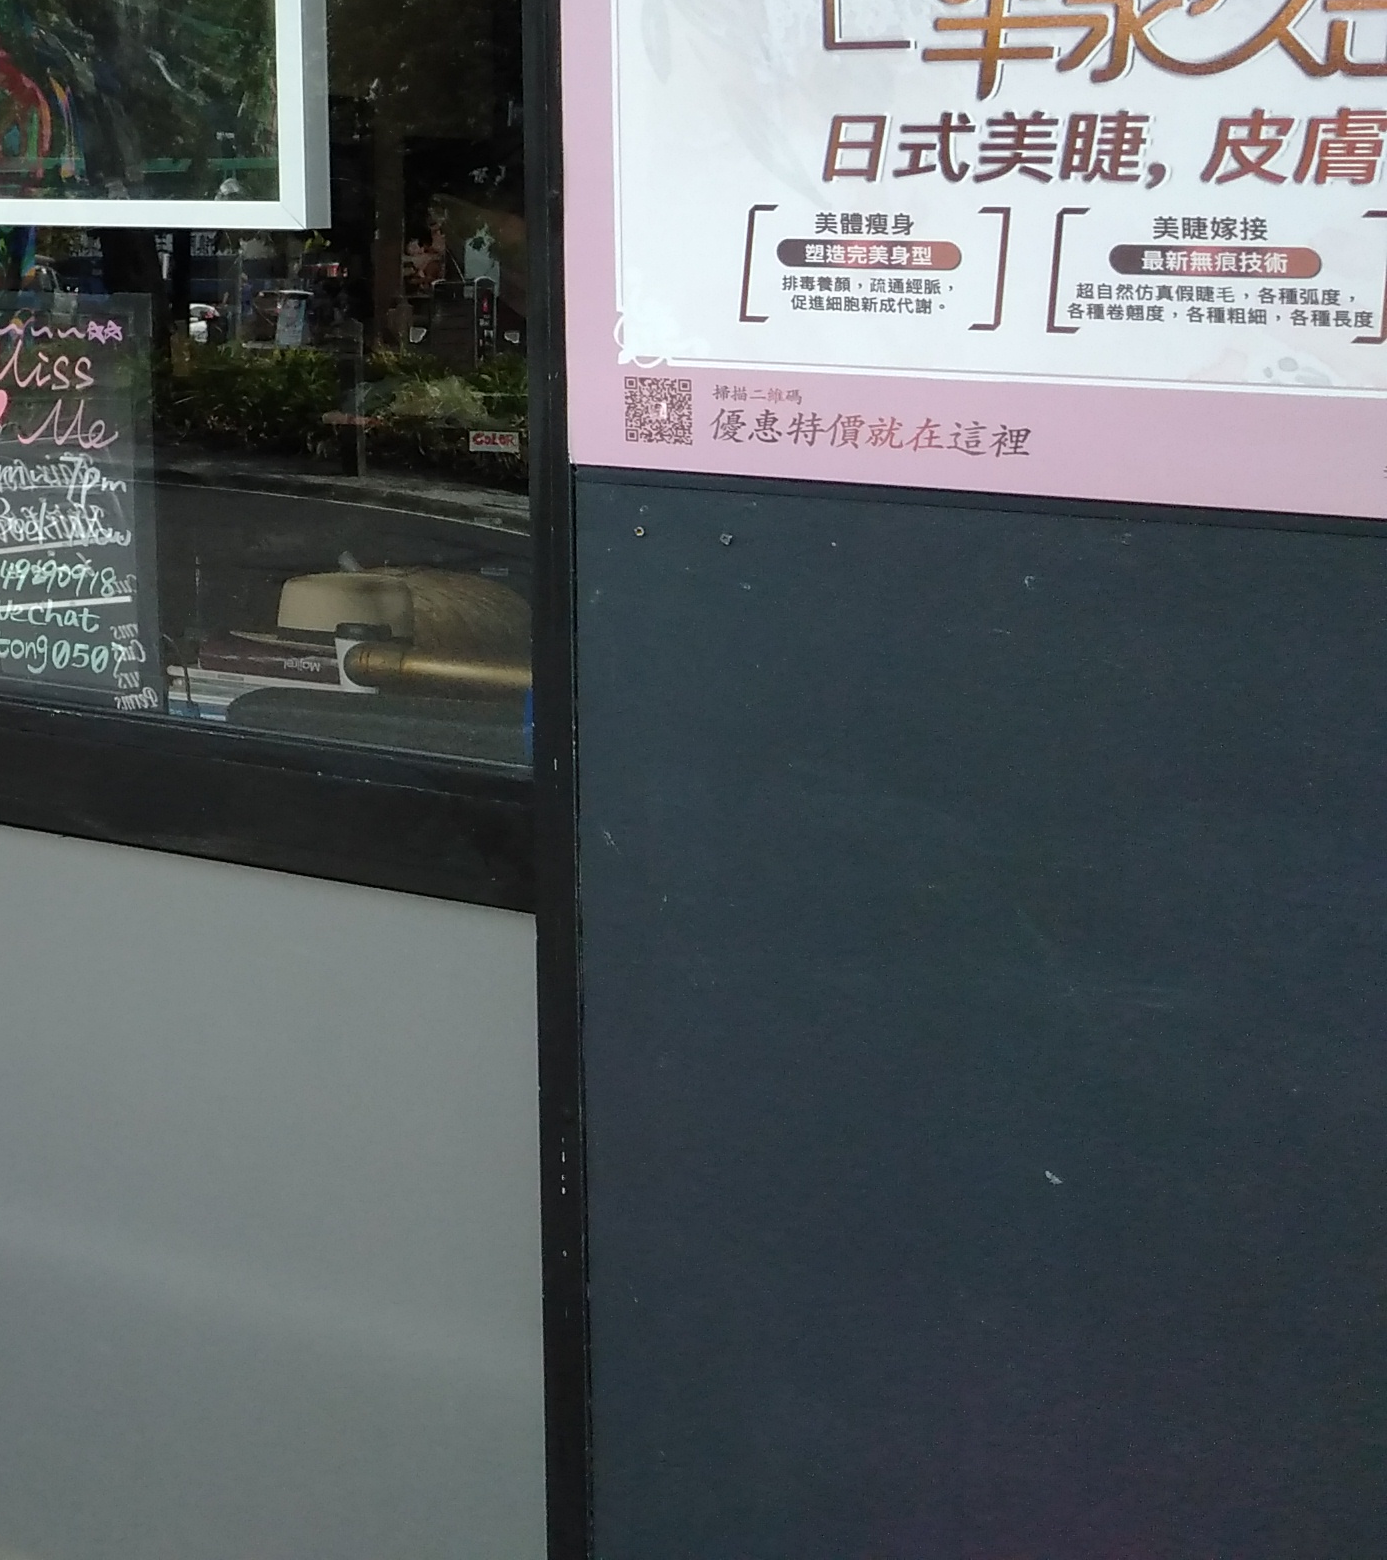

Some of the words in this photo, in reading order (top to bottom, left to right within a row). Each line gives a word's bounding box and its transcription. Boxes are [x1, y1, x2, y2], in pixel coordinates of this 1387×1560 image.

[814, 212, 915, 236] 美體瘦身
[1152, 216, 1269, 241] 美睫嫁接
[805, 243, 932, 266] 塑造完美身型
[1141, 251, 1288, 274] 最新無痕技術
[18, 399, 119, 449] Me
[709, 407, 1032, 458] 優惠特價就在這裡
[283, 659, 321, 673] Majirel
